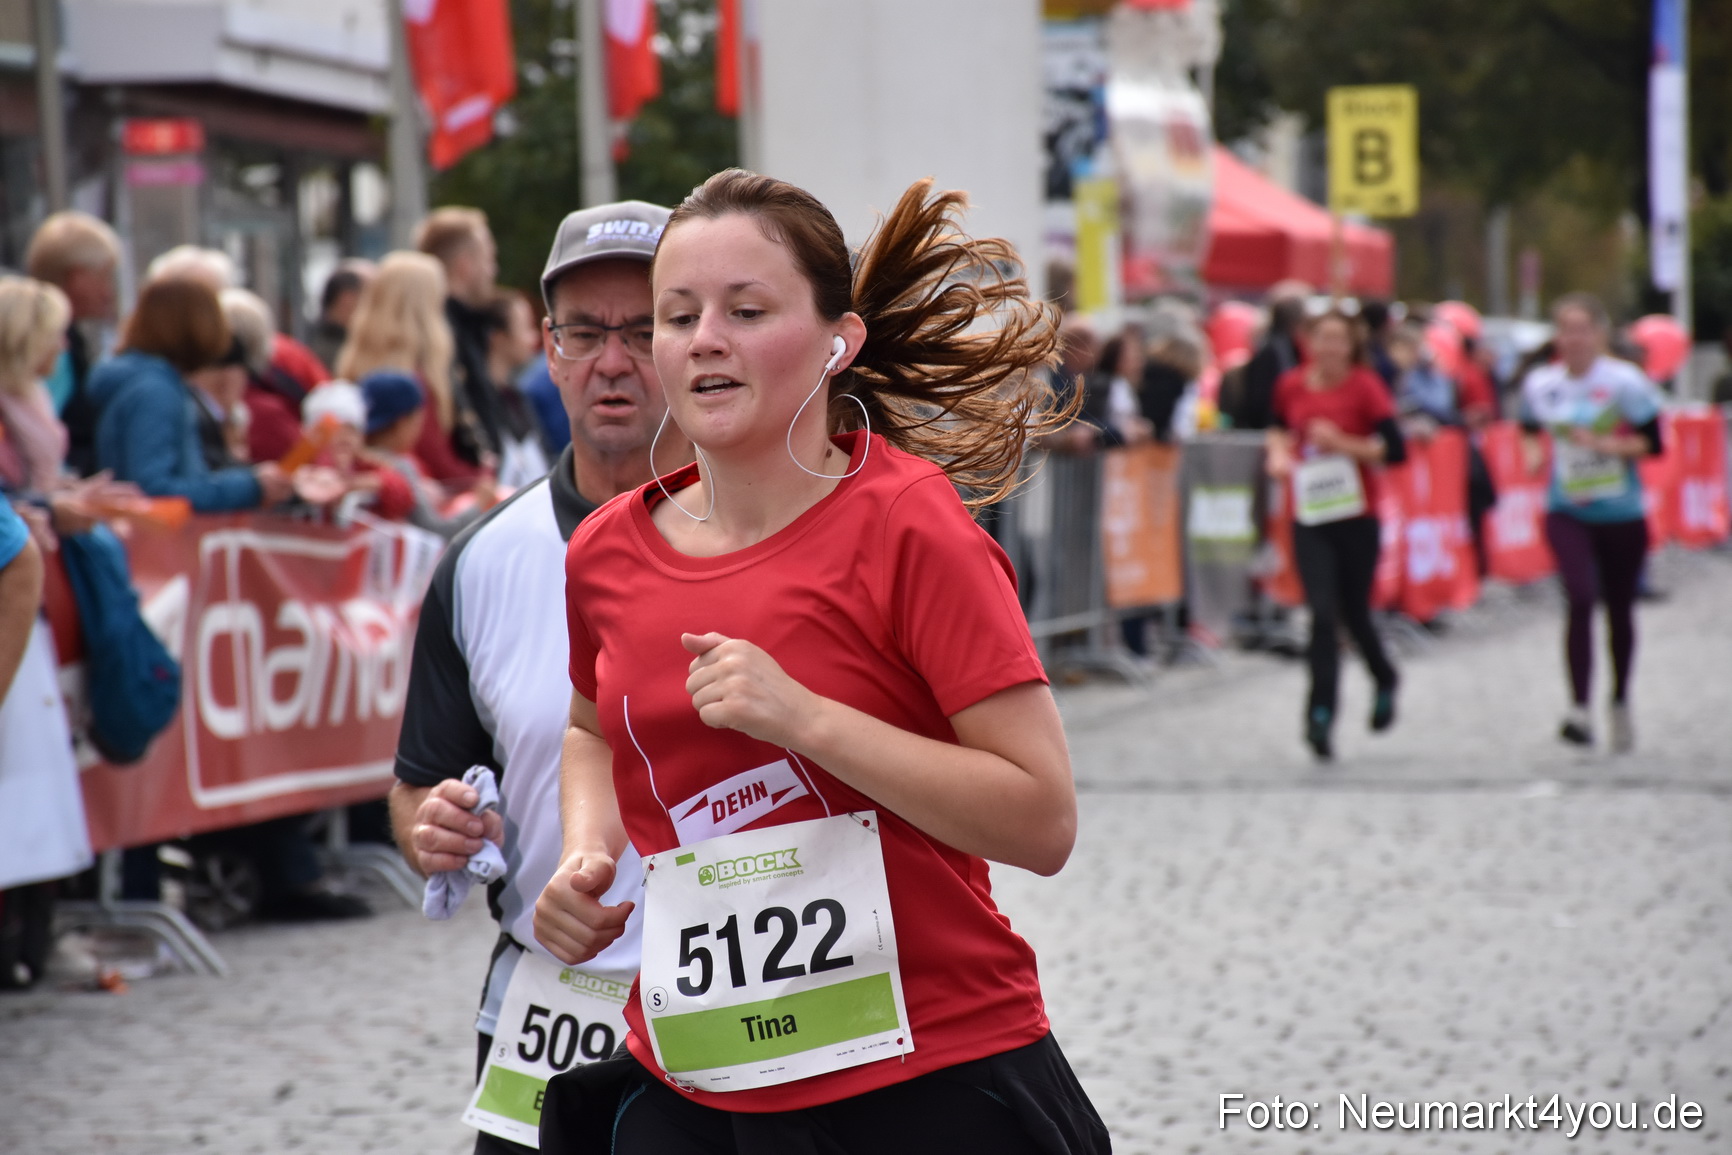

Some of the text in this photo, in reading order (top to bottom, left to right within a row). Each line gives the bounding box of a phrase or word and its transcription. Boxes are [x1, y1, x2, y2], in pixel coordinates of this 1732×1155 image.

[1352, 127, 1394, 187] B
[711, 781, 769, 825] DEHN
[716, 848, 802, 883] BOCK
[719, 869, 804, 890] inspired by smart concepts
[676, 898, 854, 997] 5122
[572, 970, 632, 1001] BOCK
[653, 993, 662, 1007] S
[517, 1004, 616, 1072] 509
[740, 1013, 798, 1042] Tina
